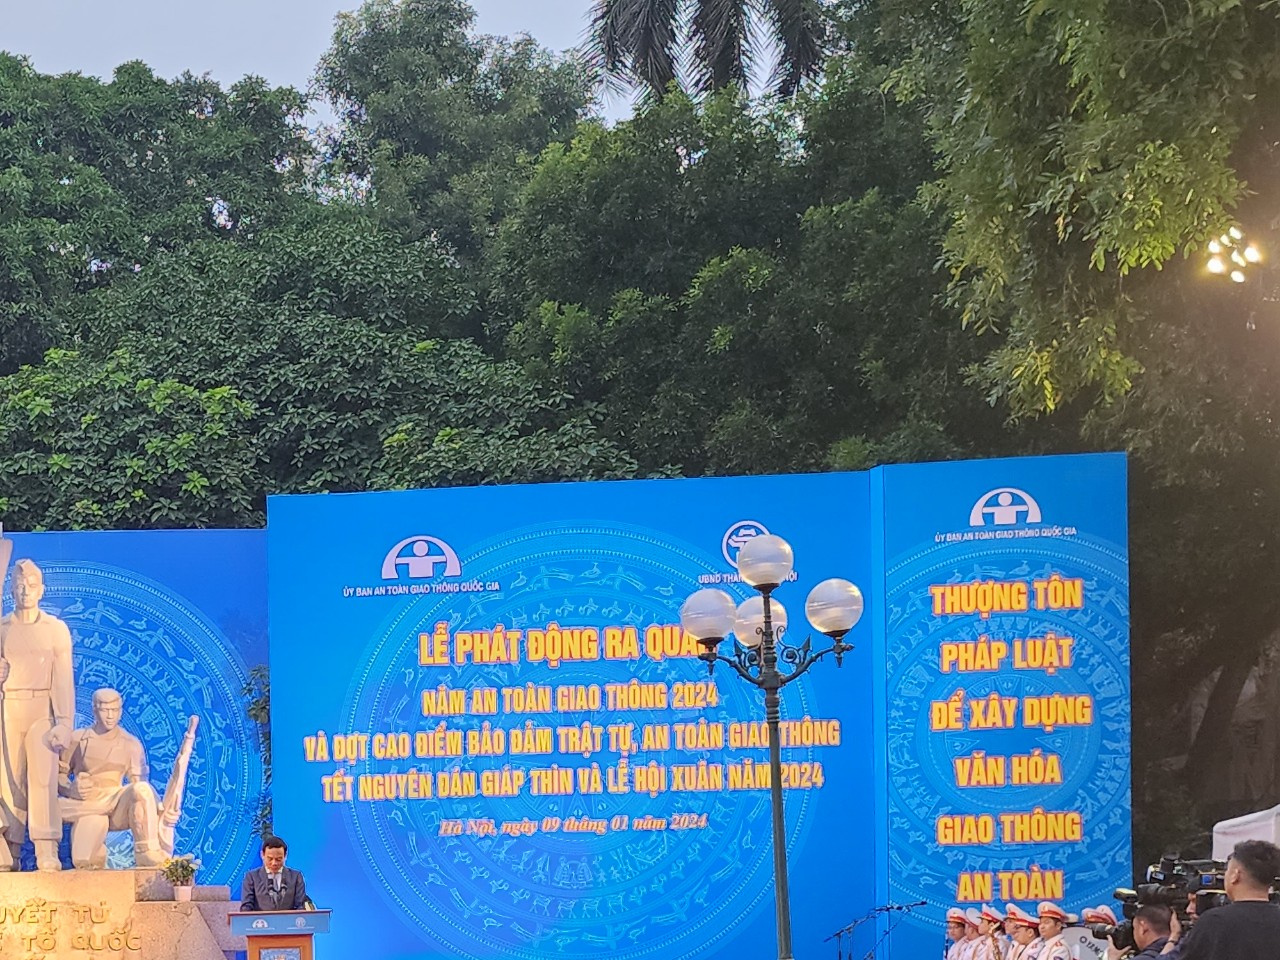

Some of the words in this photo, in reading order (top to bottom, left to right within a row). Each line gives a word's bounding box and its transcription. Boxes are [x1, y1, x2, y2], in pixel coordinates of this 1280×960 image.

[343, 586, 354, 597] ỦY
[356, 586, 372, 596] BAN
[374, 586, 385, 595] AN
[387, 584, 408, 595] TOÀN
[410, 584, 430, 594] GIAO
[431, 582, 459, 593] THÔNG
[461, 579, 483, 592] QUỐC
[486, 582, 499, 591] GIA
[698, 574, 721, 583] UBND
[930, 580, 1028, 619] THƯỢNG
[1033, 573, 1083, 610] TÔN
[419, 622, 450, 665] LỄ
[455, 624, 521, 663] PHÁT
[527, 622, 598, 668] ĐỘNG
[604, 627, 638, 659] RA
[941, 635, 1007, 672] PHÁP
[1013, 632, 1073, 674] LUẬT
[422, 684, 465, 715] NĂM
[472, 689, 497, 714] AN
[502, 682, 551, 713] TOÀN
[556, 686, 600, 711] GIAO
[606, 679, 667, 710] THÔNG
[673, 682, 718, 708] 2024
[931, 688, 964, 730] ĐỂ
[970, 693, 1018, 728] XÂY
[1023, 693, 1092, 732] DỰNG
[304, 731, 329, 761] VÀ
[333, 732, 368, 765] ĐỢT
[373, 733, 410, 759] CAO
[415, 721, 463, 757] ĐIỂM
[468, 720, 505, 756] BẢO
[509, 719, 552, 753] ĐẢM
[557, 721, 603, 757] TRẬT
[609, 722, 638, 755] TỰ,
[642, 724, 668, 751] AN
[674, 717, 723, 750] TOÀN
[778, 715, 840, 747] THÔNG
[322, 769, 354, 802] TẾT
[358, 768, 432, 801] NGUYÊN
[437, 766, 476, 798] ĐÁN
[481, 765, 524, 797] GIÁP
[530, 764, 573, 796] THÌN
[578, 762, 603, 793] VÀ
[607, 758, 629, 793] LỄ
[634, 761, 667, 797] HỘI
[671, 760, 723, 791] XUÂN
[728, 758, 771, 789] NĂM
[781, 763, 824, 789] 2024
[954, 750, 1005, 787] VĂN
[1011, 748, 1062, 785] HÓA
[439, 819, 463, 836] Hà
[467, 818, 497, 837] Nội,
[501, 819, 537, 836] ngày
[542, 817, 560, 832] 09
[563, 816, 607, 835] tháng
[611, 815, 628, 831] 01
[633, 815, 666, 831] năm
[670, 813, 708, 829] 2024
[937, 814, 994, 845] GIAO
[1000, 807, 1082, 843] THÔNG
[957, 872, 992, 902] AN
[997, 864, 1063, 901] TOÀN
[73, 901, 112, 924] TỬ
[21, 925, 58, 951] TỔ
[72, 923, 142, 951] QUỐC
